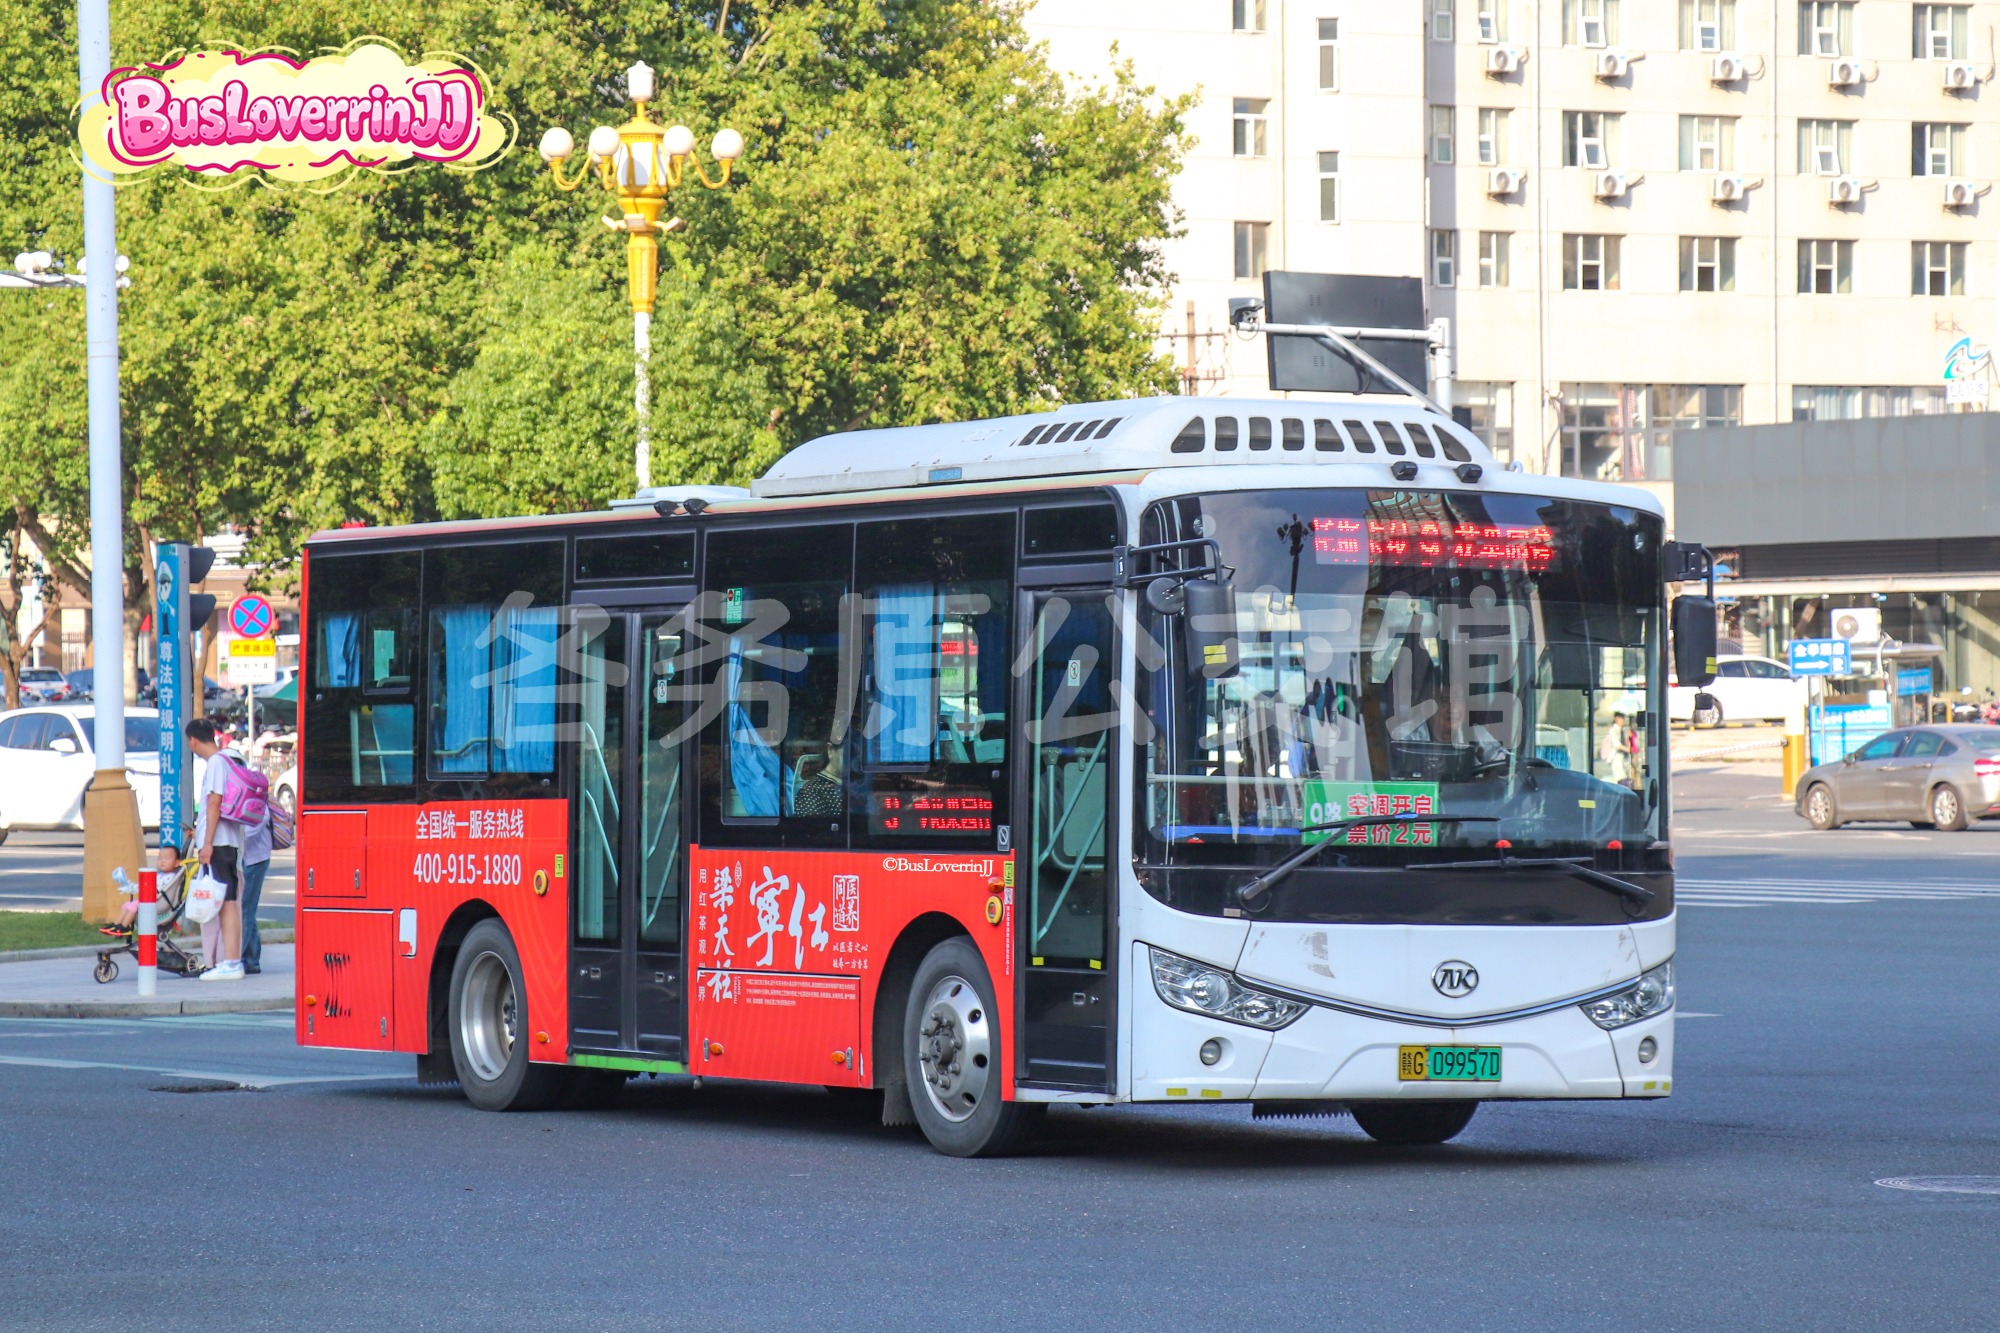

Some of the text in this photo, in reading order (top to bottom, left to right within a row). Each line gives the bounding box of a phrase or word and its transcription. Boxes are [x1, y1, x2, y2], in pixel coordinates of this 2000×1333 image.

[1347, 794, 1433, 817] 空调开启
[415, 809, 525, 840] 全国统一服务热线
[1347, 822, 1433, 845] 票价2元
[413, 853, 522, 886] 400-915-1880
